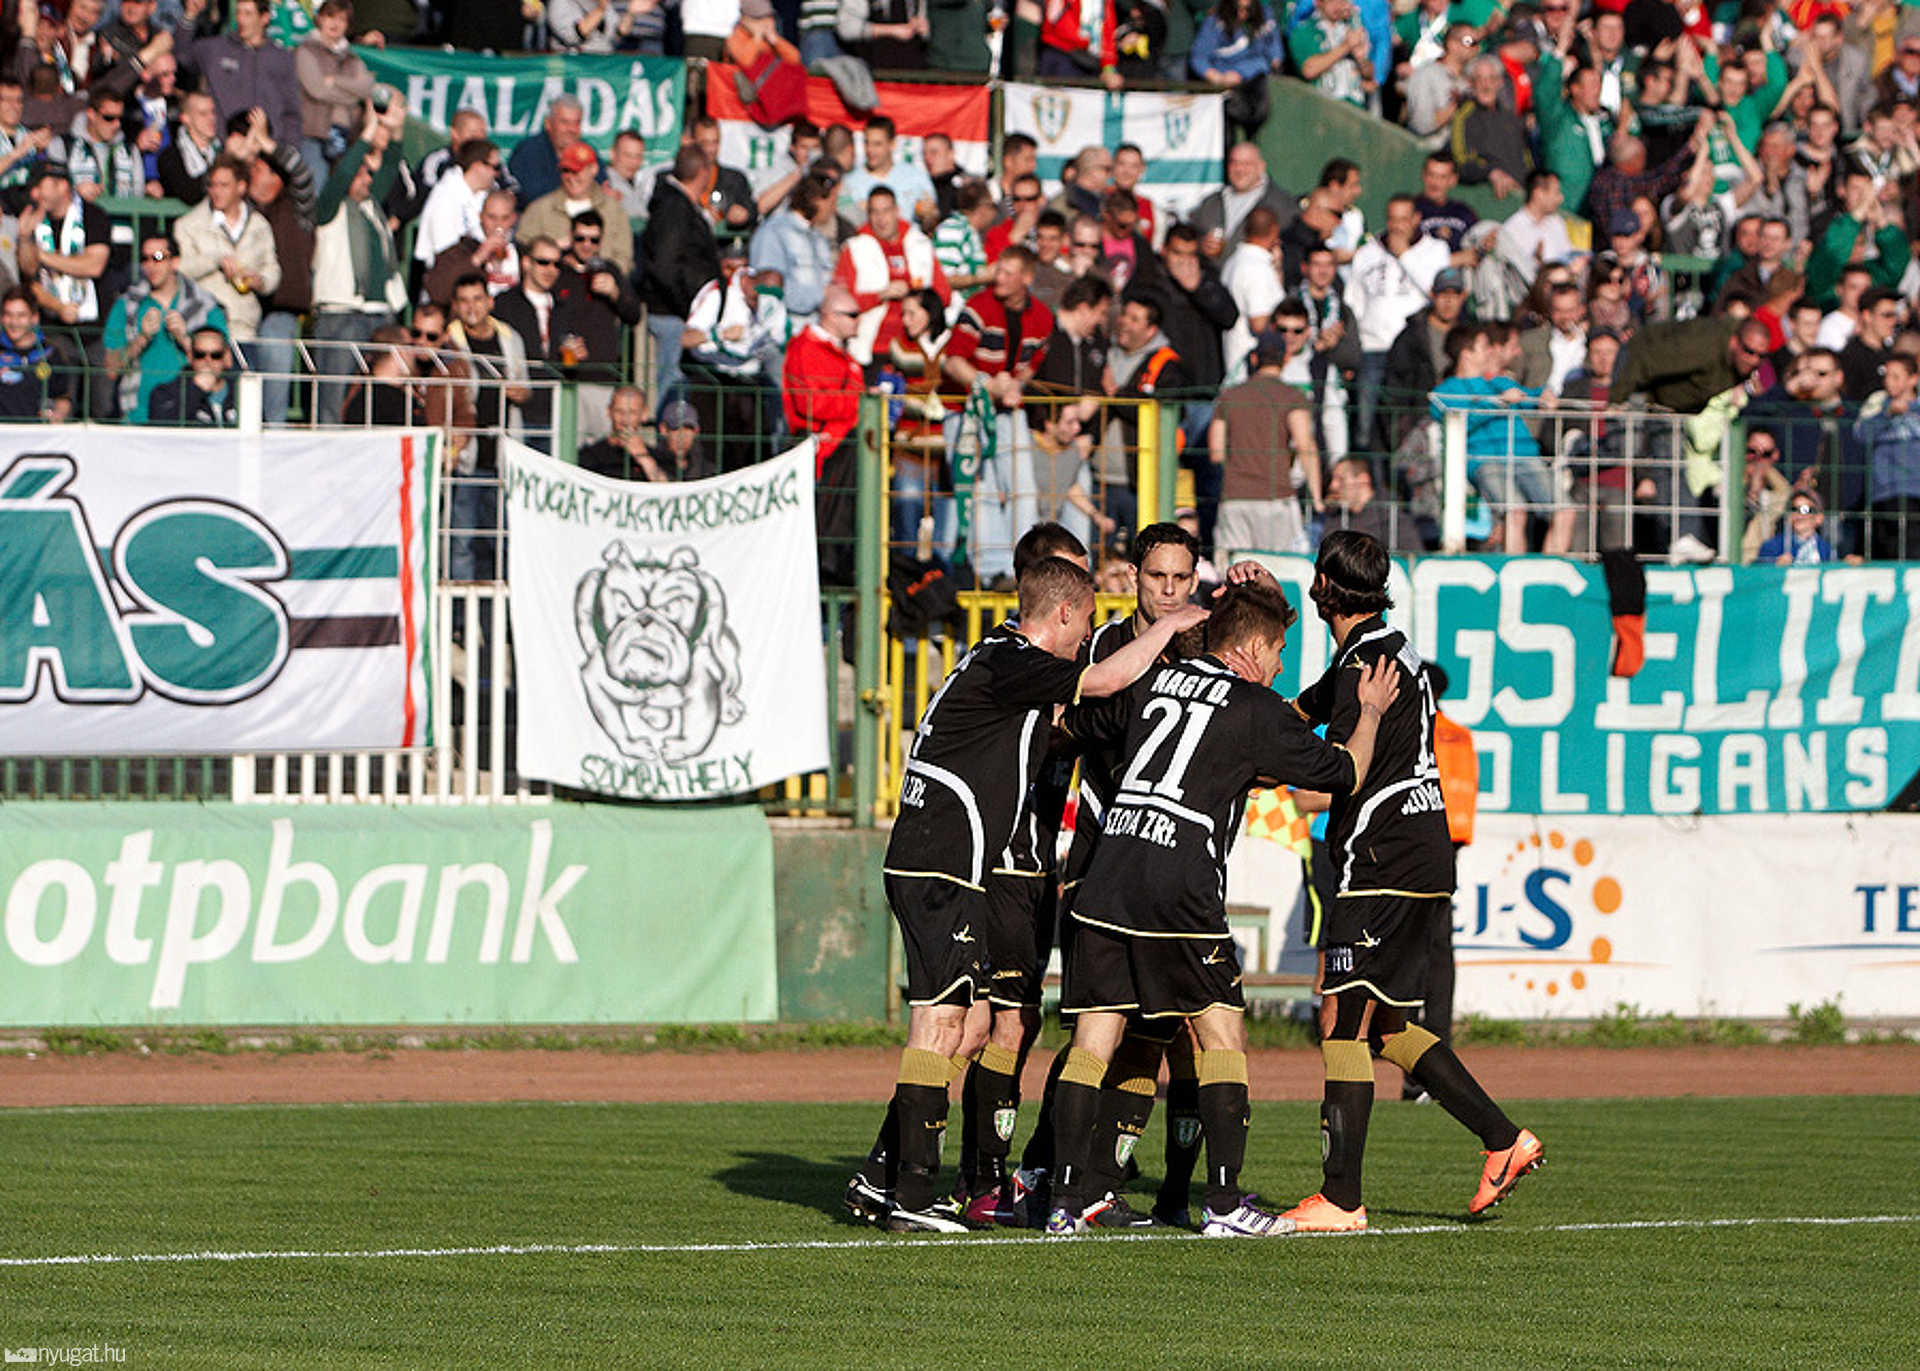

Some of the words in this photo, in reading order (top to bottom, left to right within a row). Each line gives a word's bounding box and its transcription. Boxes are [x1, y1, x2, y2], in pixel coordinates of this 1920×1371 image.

[407, 61, 676, 136] HALADÁS
[581, 751, 753, 795] SZOMBATHELY
[1120, 696, 1215, 802] 21
[4, 818, 589, 1008] otpbank
[1854, 885, 1920, 932] TE
